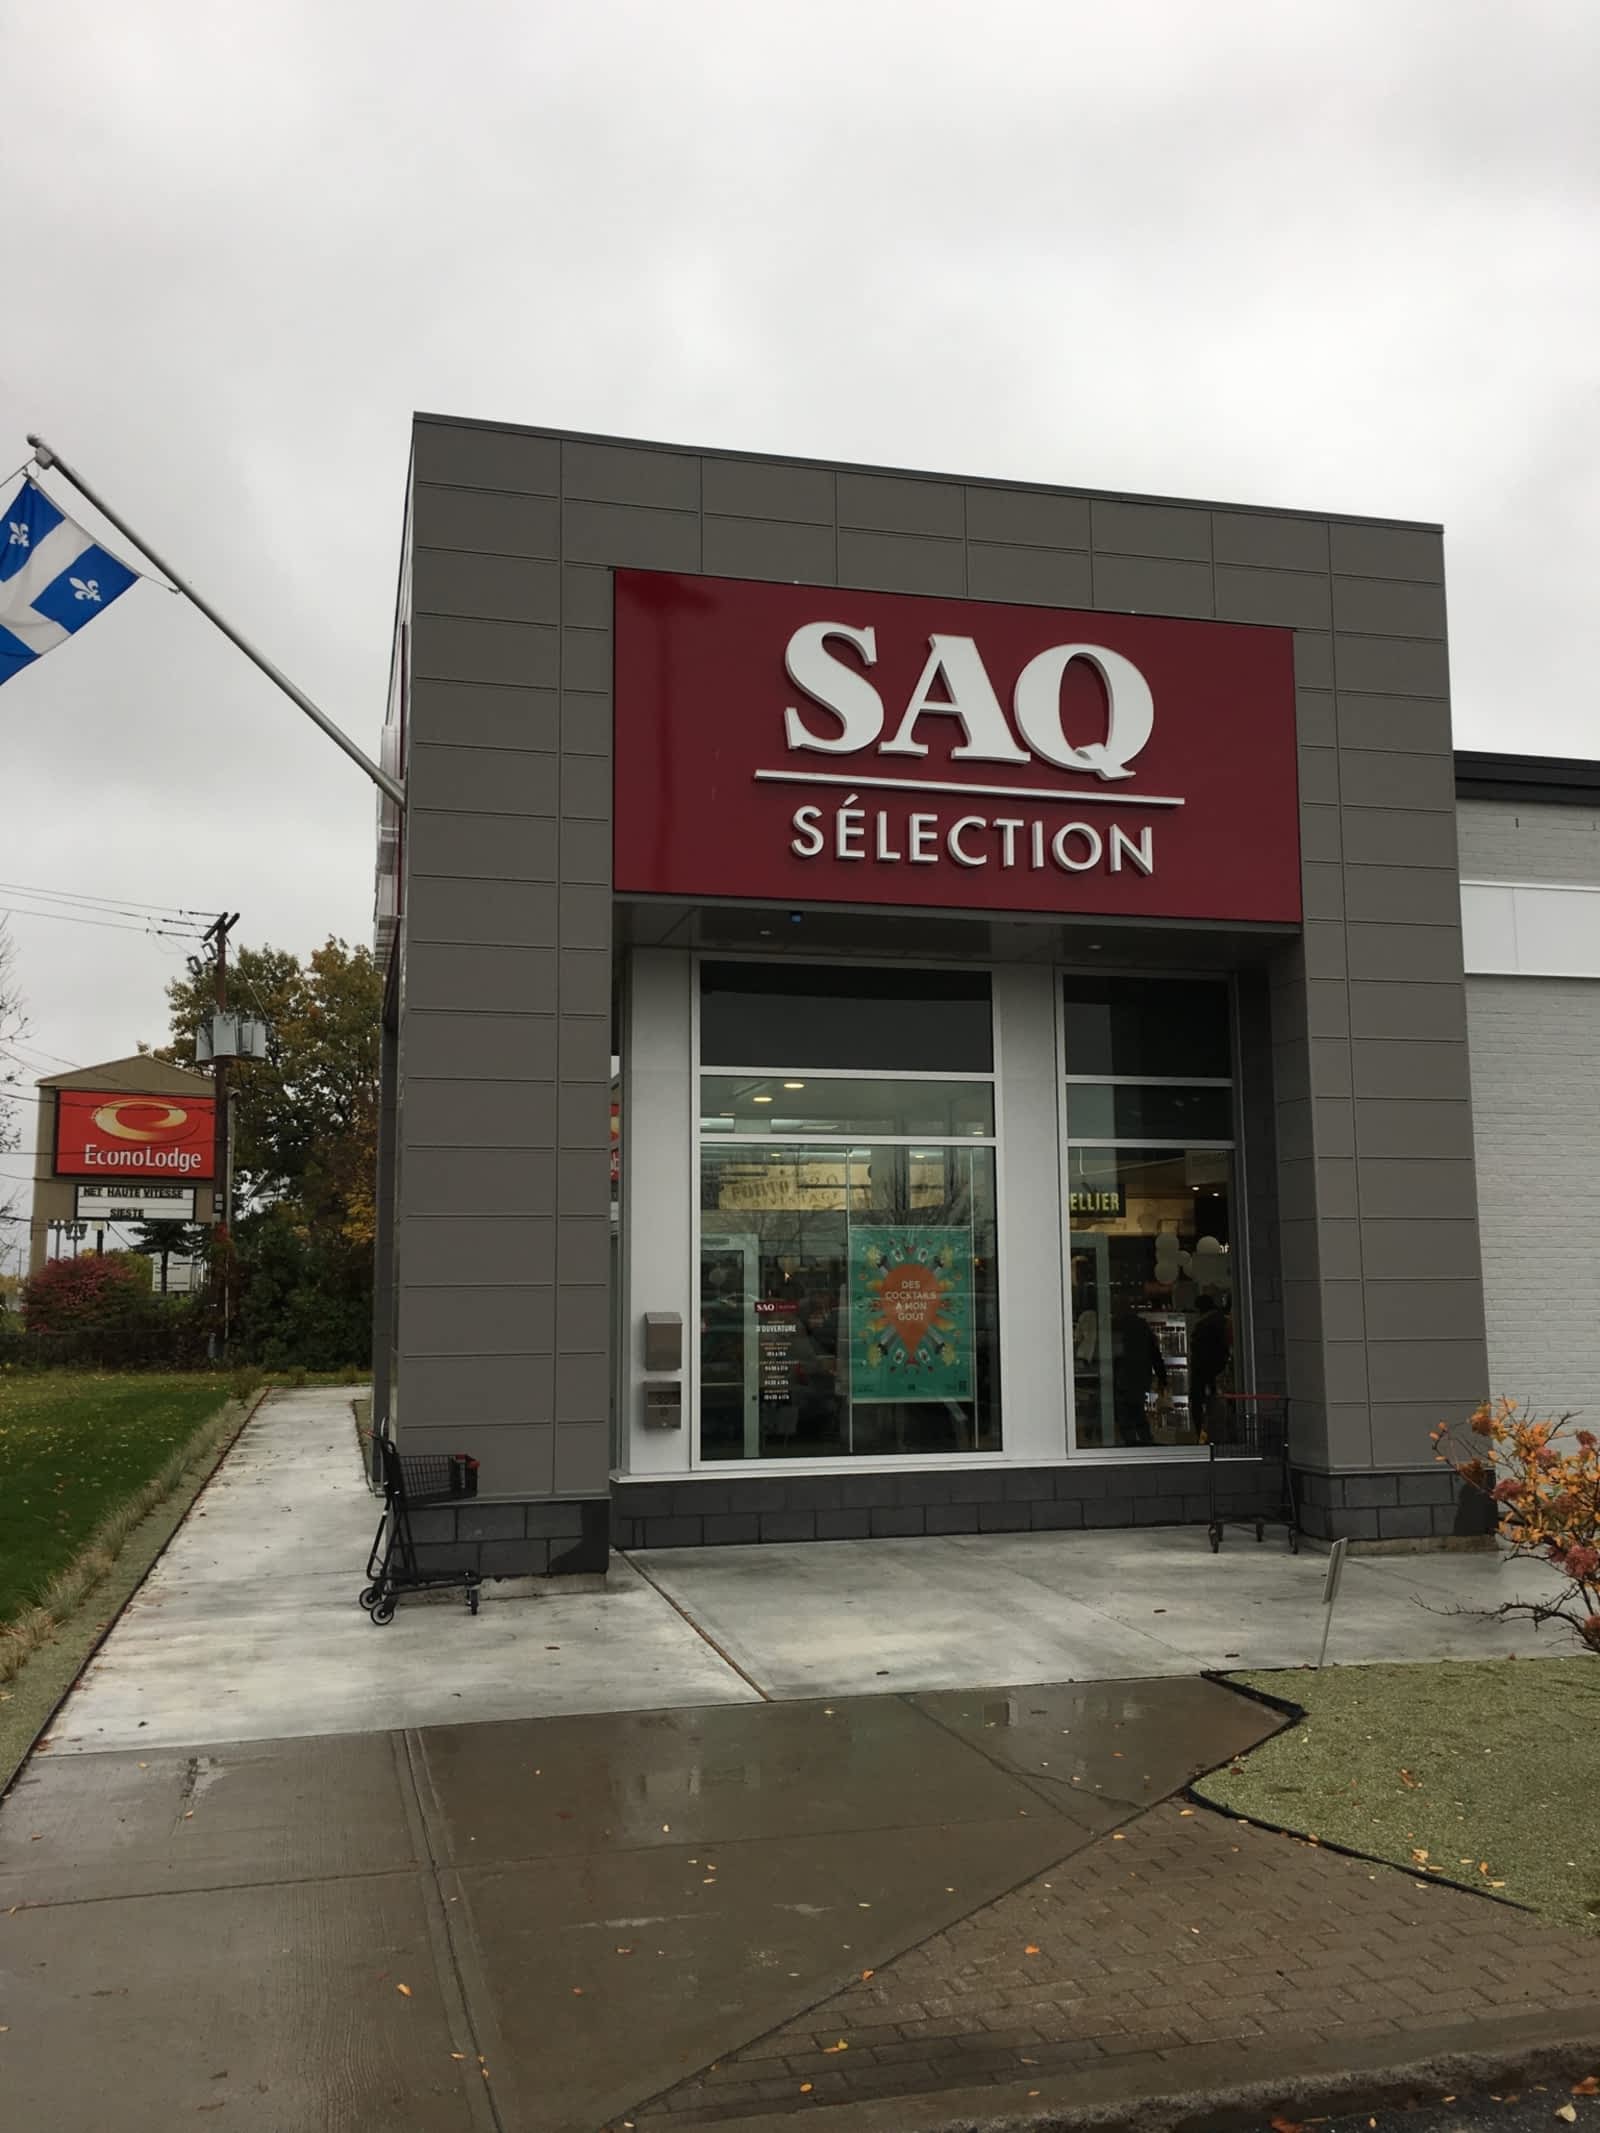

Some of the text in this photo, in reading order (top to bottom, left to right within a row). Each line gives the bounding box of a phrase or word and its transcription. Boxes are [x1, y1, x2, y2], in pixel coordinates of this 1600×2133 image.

[784, 621, 1155, 781] SAQ
[791, 793, 1153, 876] SÉLECTION
[107, 1188, 140, 1198] HAUTE
[143, 1189, 183, 1199] VITESSE
[901, 1280, 921, 1289] DES
[905, 1301, 927, 1311] MON
